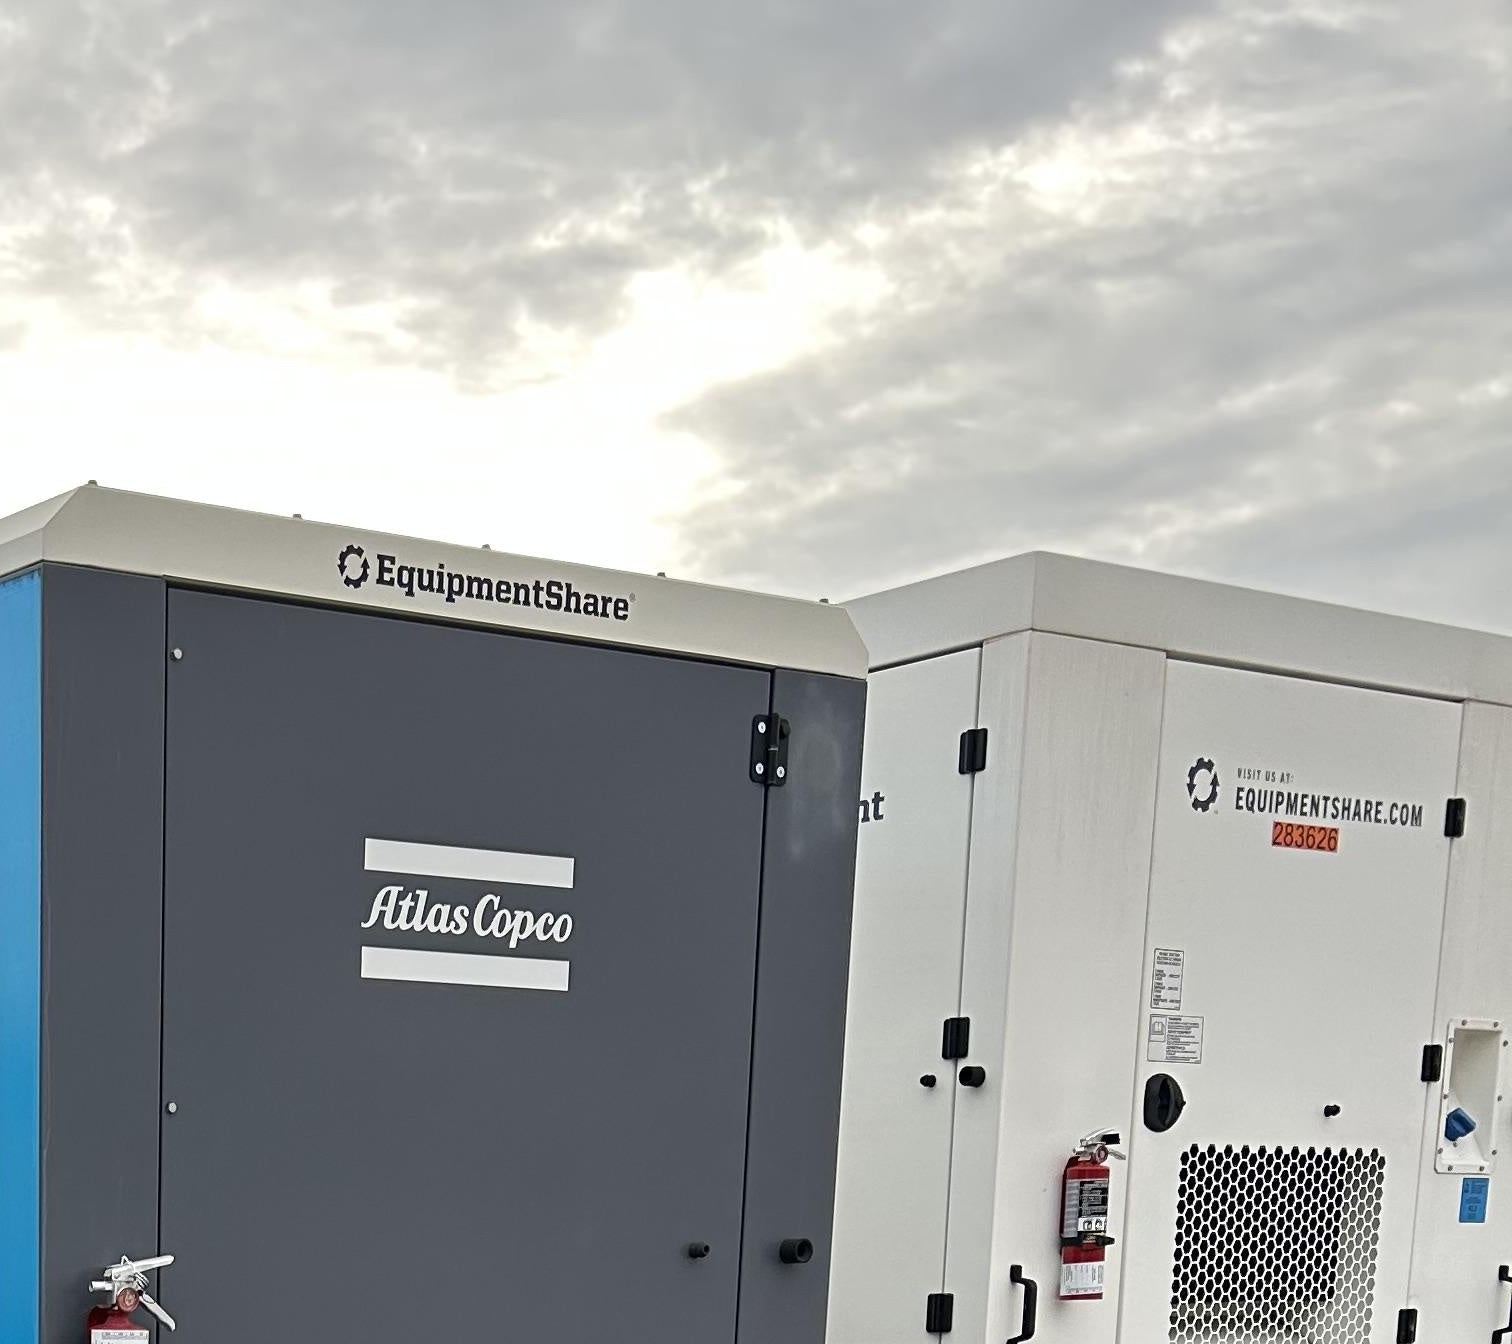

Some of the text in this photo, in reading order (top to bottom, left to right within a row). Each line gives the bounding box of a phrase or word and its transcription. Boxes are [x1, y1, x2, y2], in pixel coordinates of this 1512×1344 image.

[375, 553, 629, 621] EquipmentShare
[1237, 767, 1262, 781] VISIT
[1265, 770, 1276, 783] US
[1235, 786, 1424, 827] EQUIPMENTSHARE.COM
[1272, 821, 1338, 852] 283626
[361, 886, 573, 948] Atlas Copco
